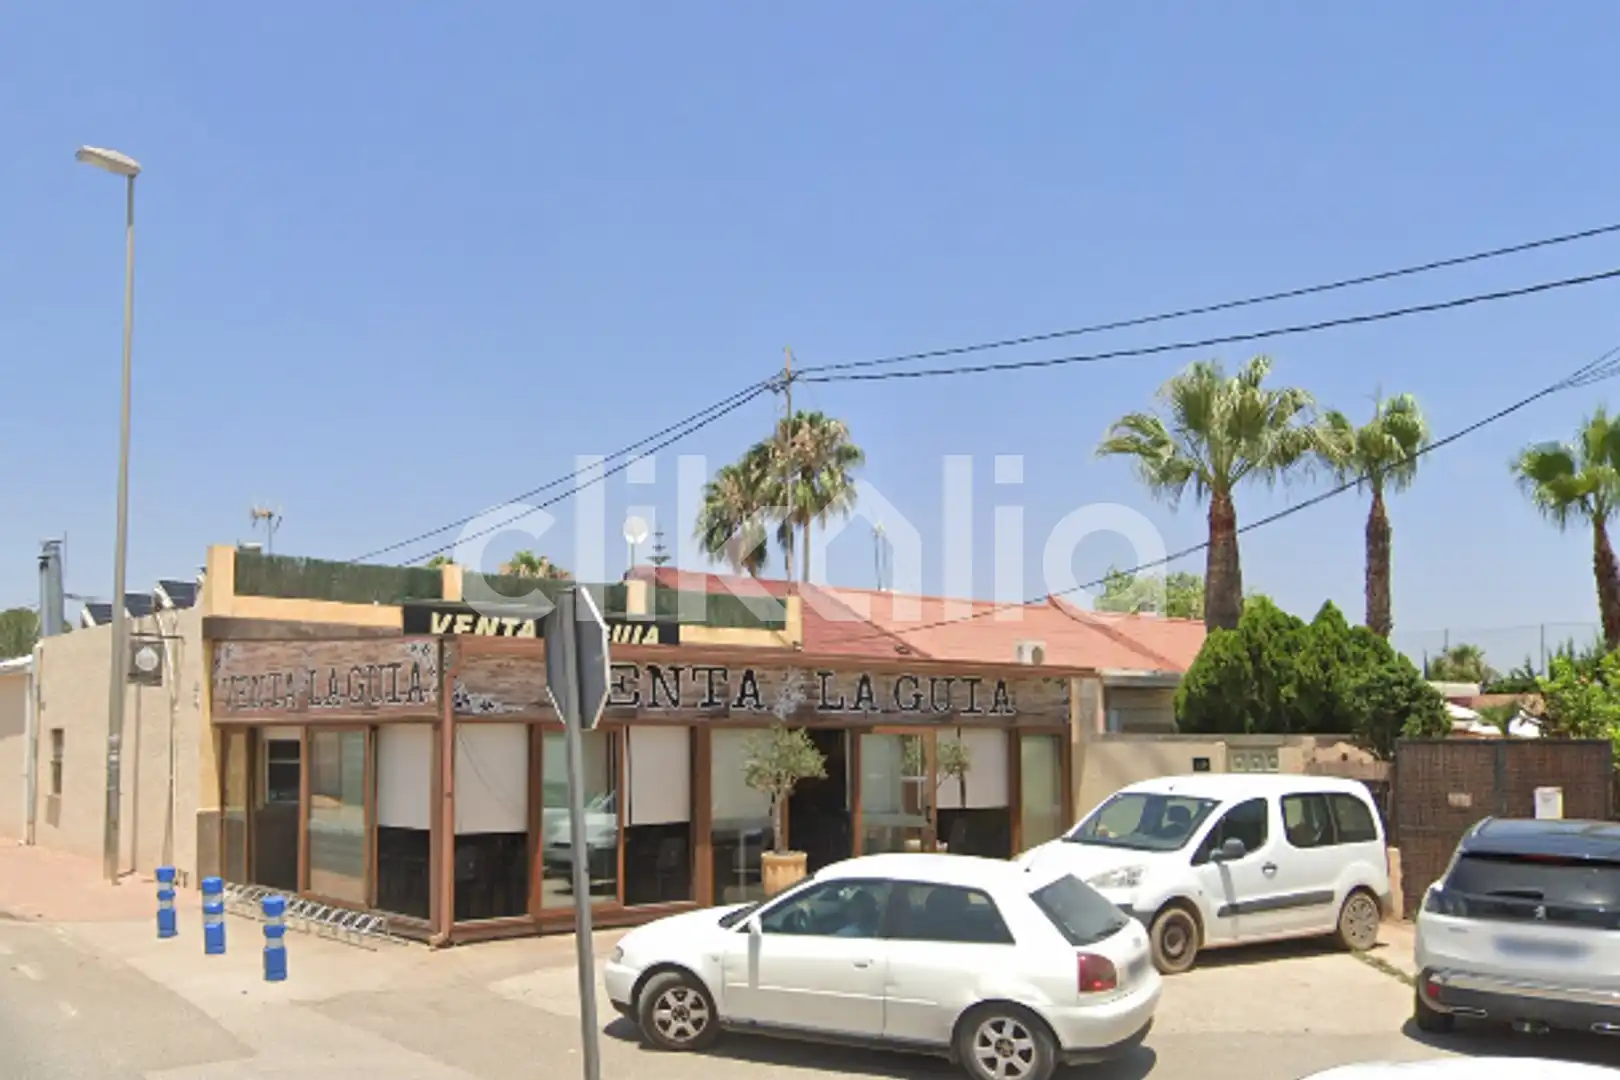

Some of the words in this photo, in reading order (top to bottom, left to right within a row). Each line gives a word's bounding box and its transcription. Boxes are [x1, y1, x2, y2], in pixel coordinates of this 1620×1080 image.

[430, 611, 537, 638] VENTA
[608, 623, 660, 645] UIA
[606, 662, 768, 711] ENTA
[815, 670, 881, 713] LA
[893, 673, 1017, 715] GUIA
